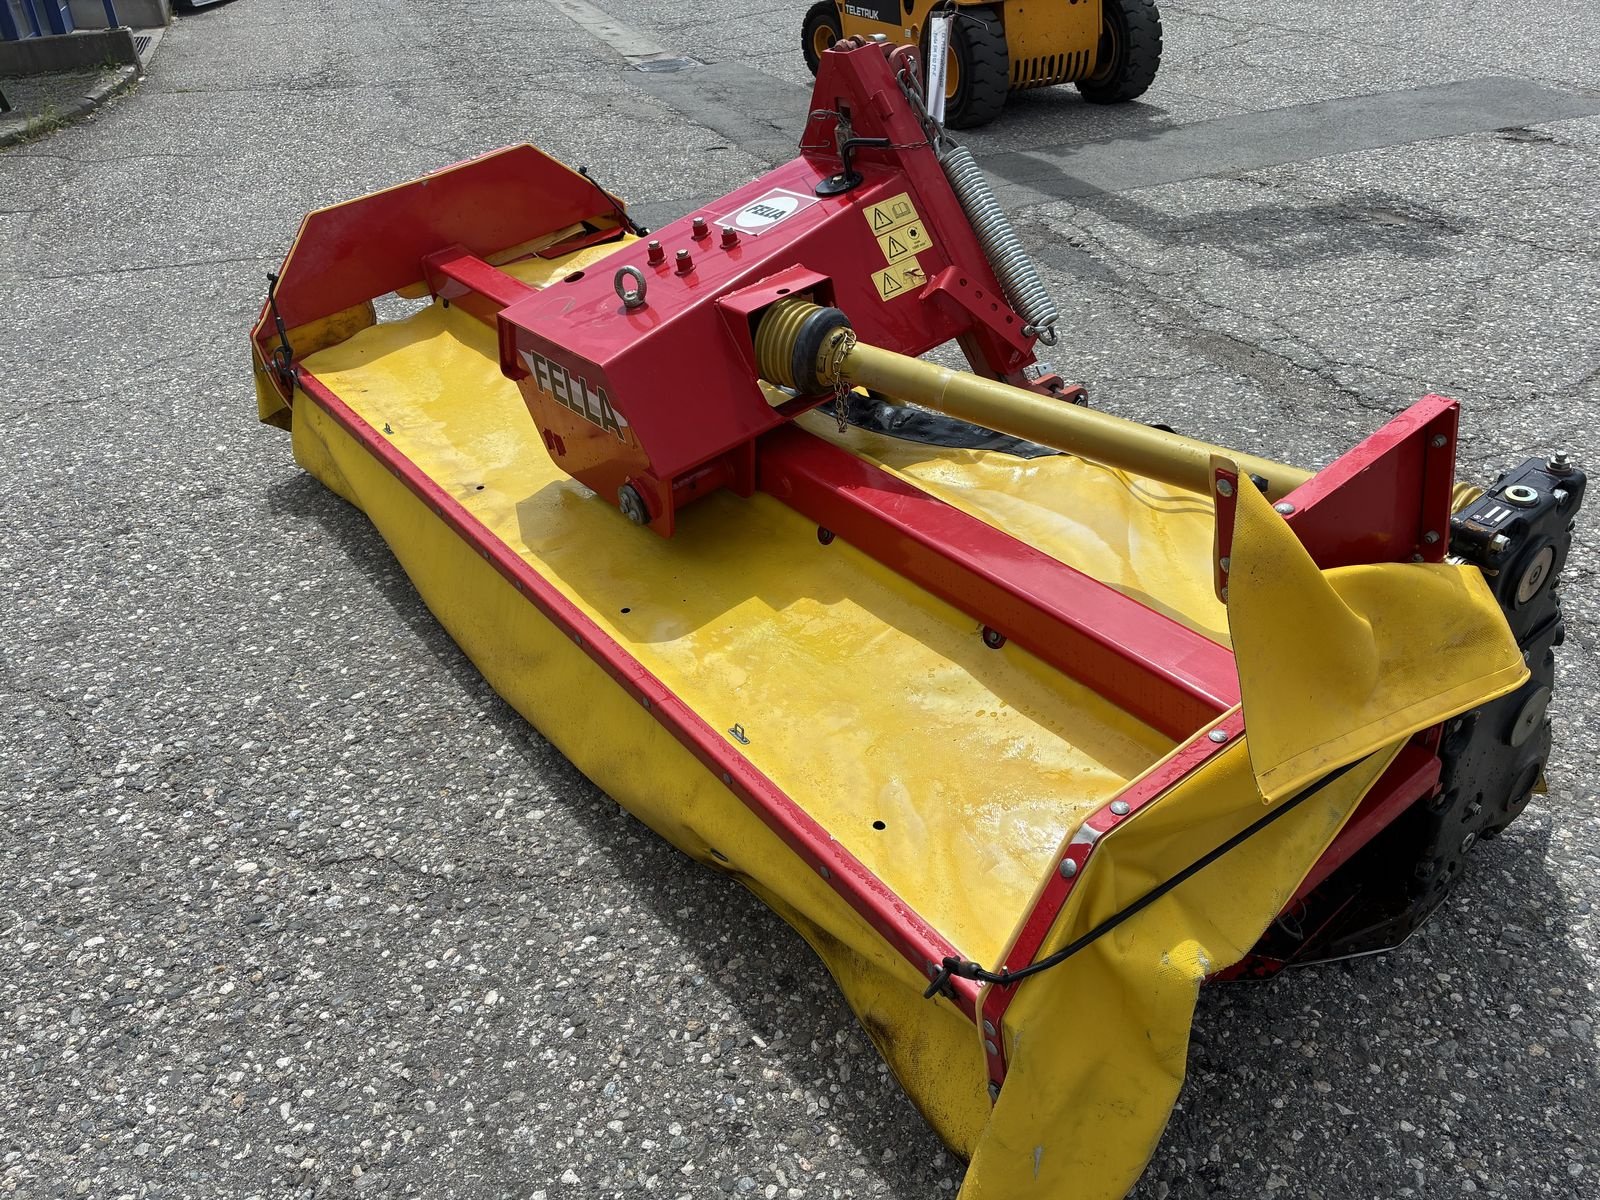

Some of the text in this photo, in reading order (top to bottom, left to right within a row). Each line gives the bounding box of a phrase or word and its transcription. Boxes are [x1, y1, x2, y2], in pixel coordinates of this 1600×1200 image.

[845, 4, 879, 20] TELETRUK
[745, 204, 786, 220] FELLA
[531, 349, 626, 443] FELLA
